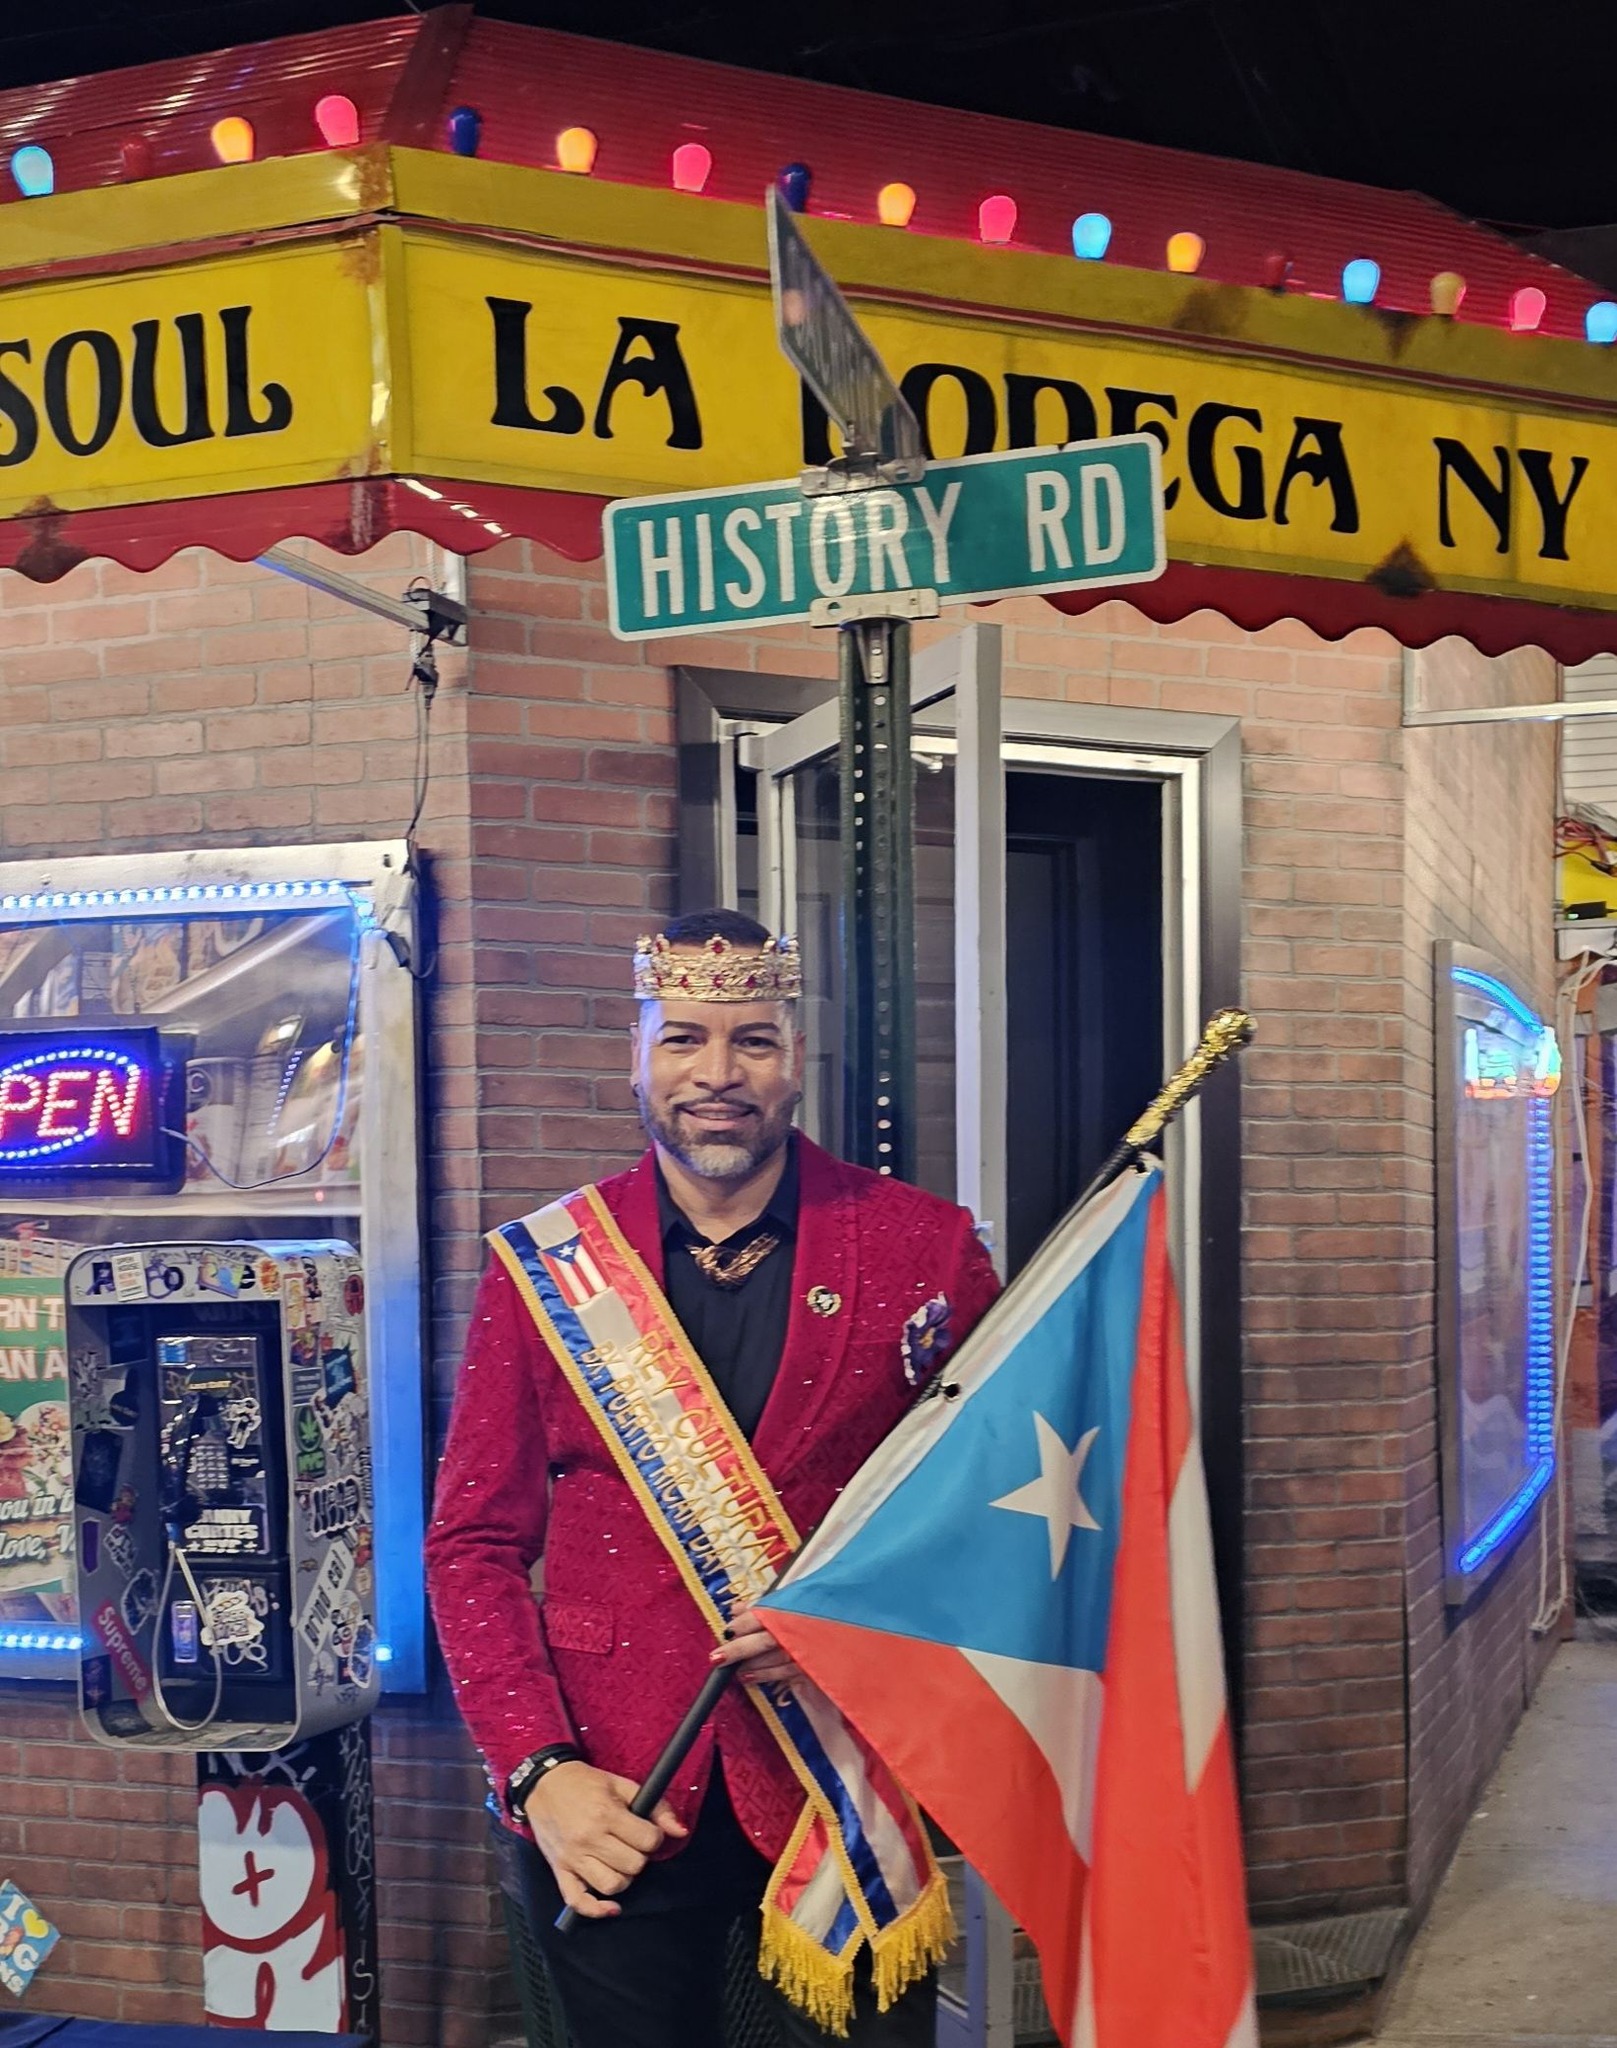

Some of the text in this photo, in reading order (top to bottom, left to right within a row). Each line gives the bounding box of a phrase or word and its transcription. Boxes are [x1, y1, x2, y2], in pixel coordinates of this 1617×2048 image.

[486, 296, 703, 450] LA
[1433, 437, 1590, 561] NY
[639, 463, 1126, 618] HISTORY RD
[33, 1489, 56, 1516] in
[600, 1374, 672, 1461] PUERTO
[651, 1461, 708, 1532] RICAN
[690, 1531, 735, 1576] DAY
[628, 1332, 786, 1585] REY CULTURAL
[97, 1605, 148, 1690] Supreme
